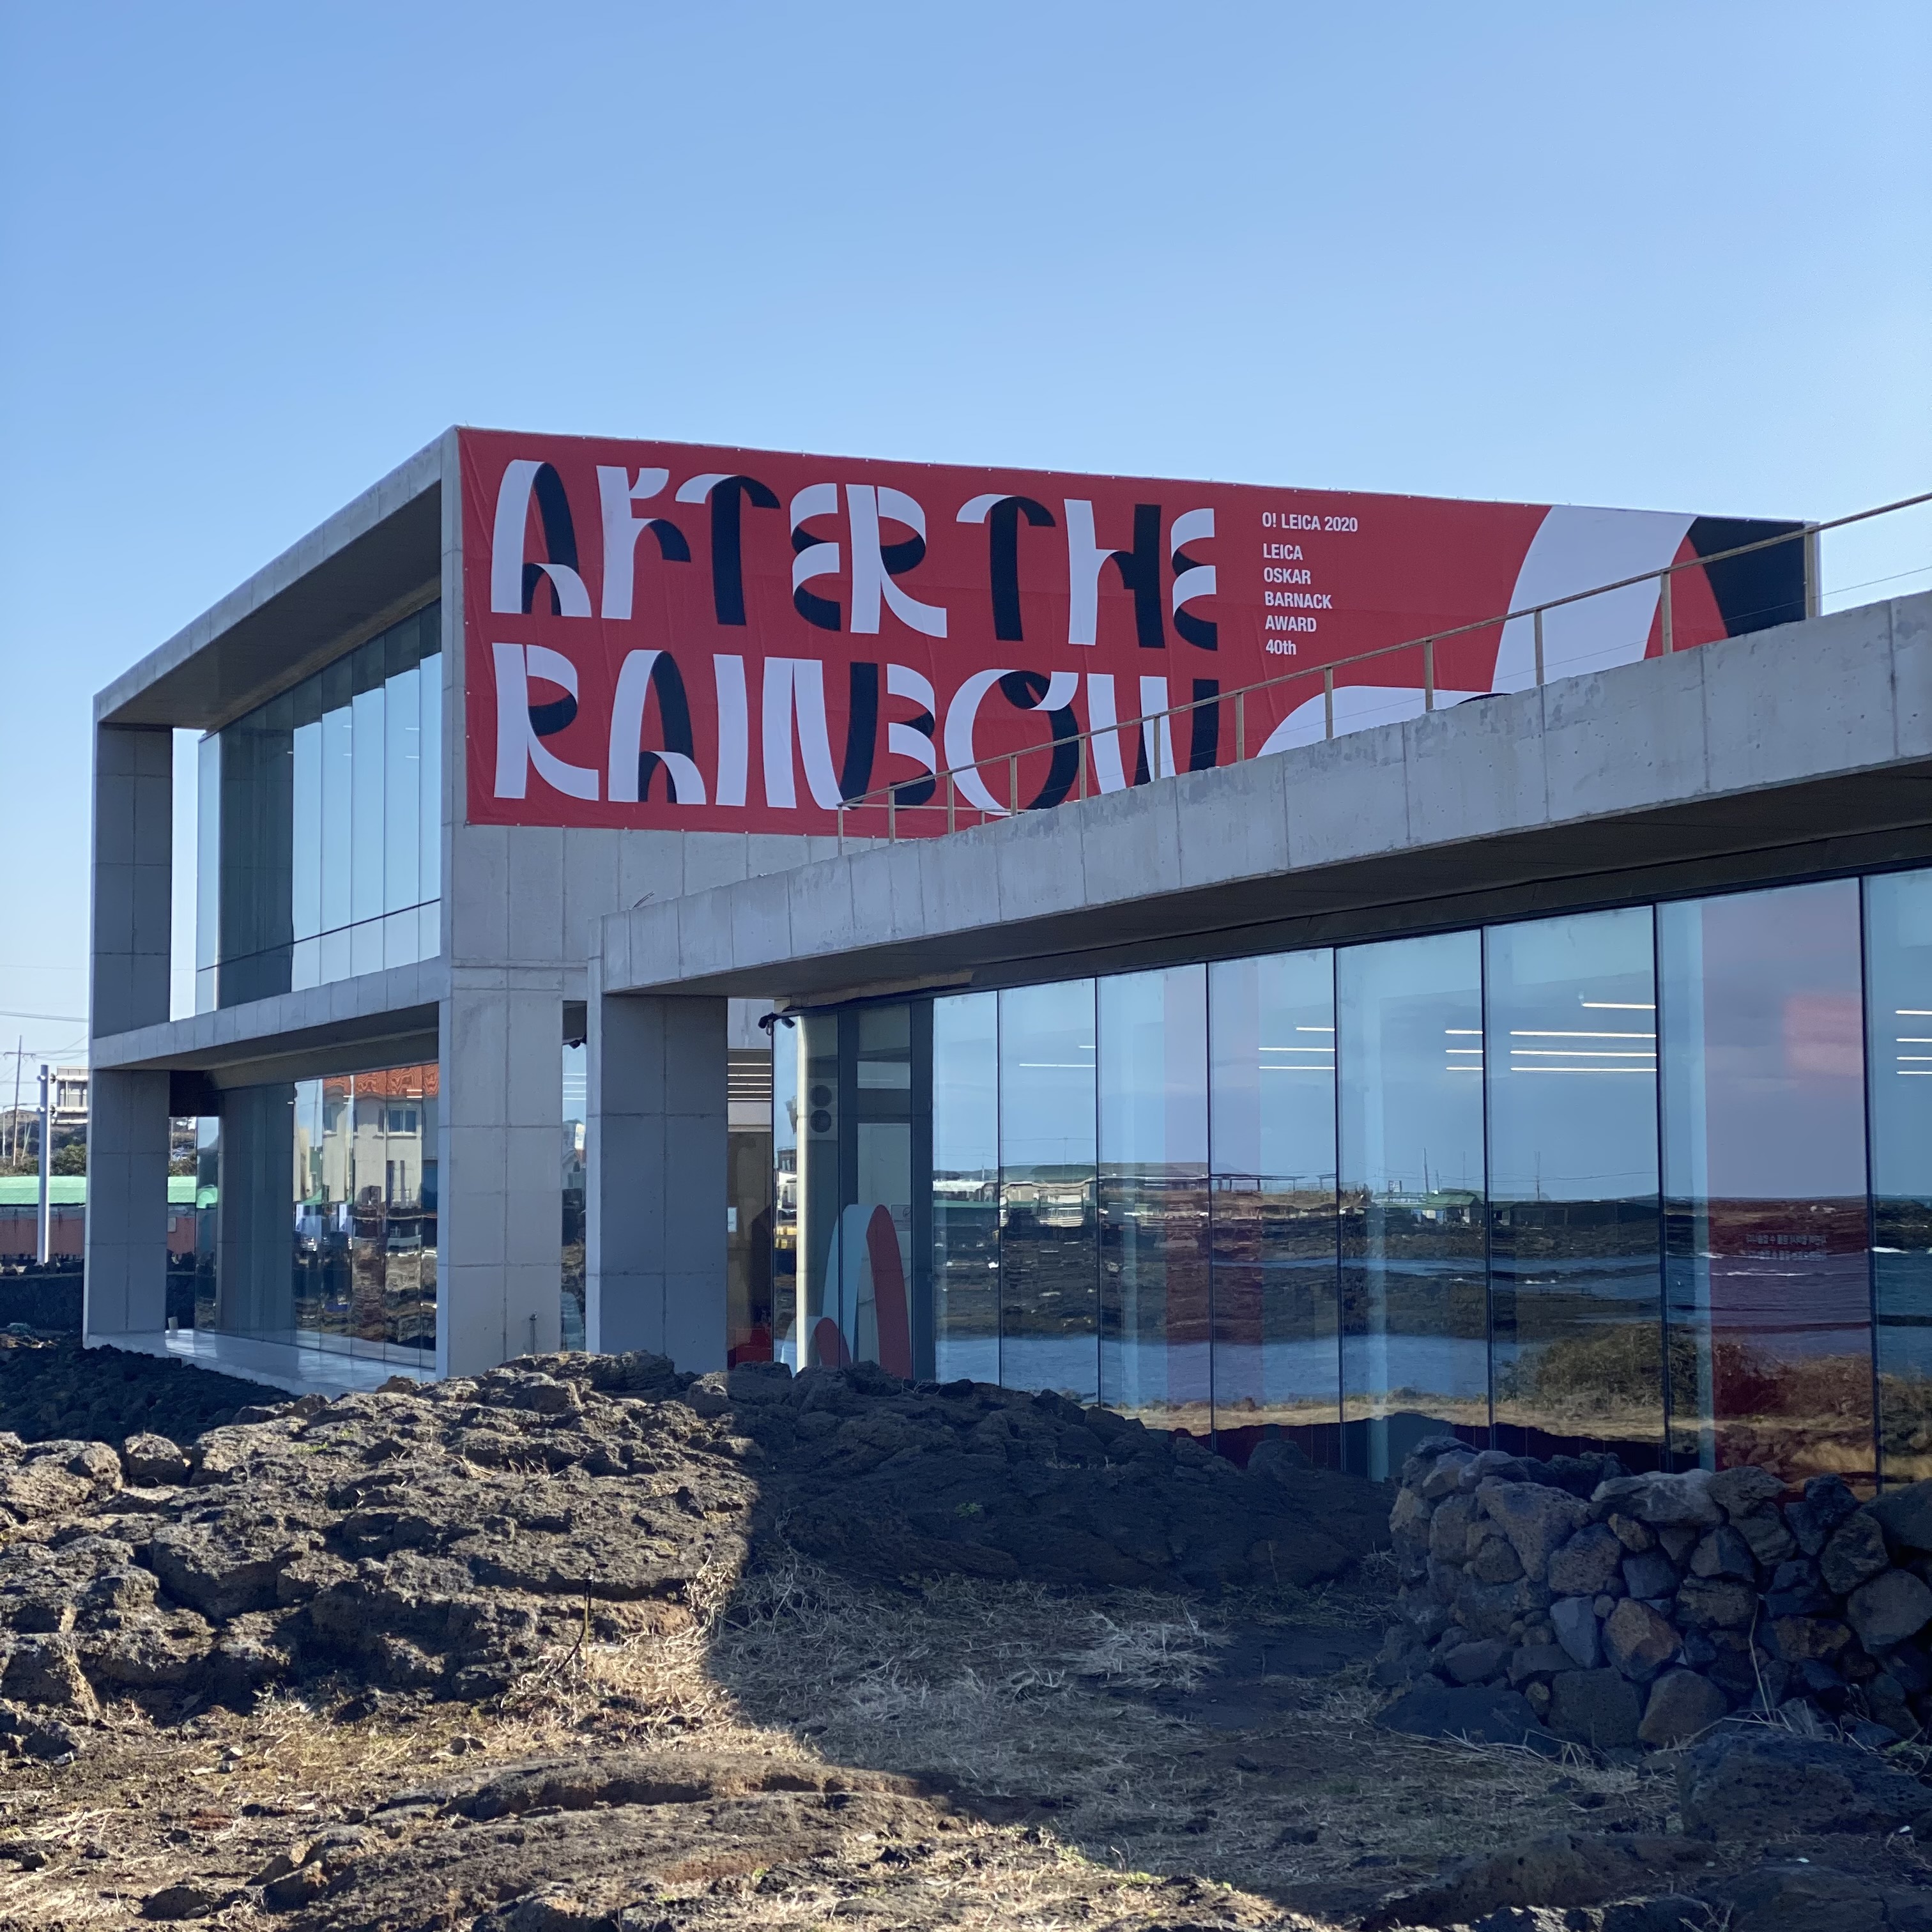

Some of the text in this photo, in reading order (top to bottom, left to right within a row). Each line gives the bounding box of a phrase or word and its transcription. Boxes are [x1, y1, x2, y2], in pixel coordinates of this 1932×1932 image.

[1262, 512, 1358, 532] O! LEICA 2020
[490, 459, 1218, 651] AFTER THE
[1262, 543, 1303, 560] LEICA
[1264, 567, 1311, 585] OSKAR
[1264, 591, 1333, 609] BARNACK
[1264, 615, 1317, 632] AWARD
[1266, 639, 1297, 656] 40th
[491, 642, 1219, 816] RAINBOW
